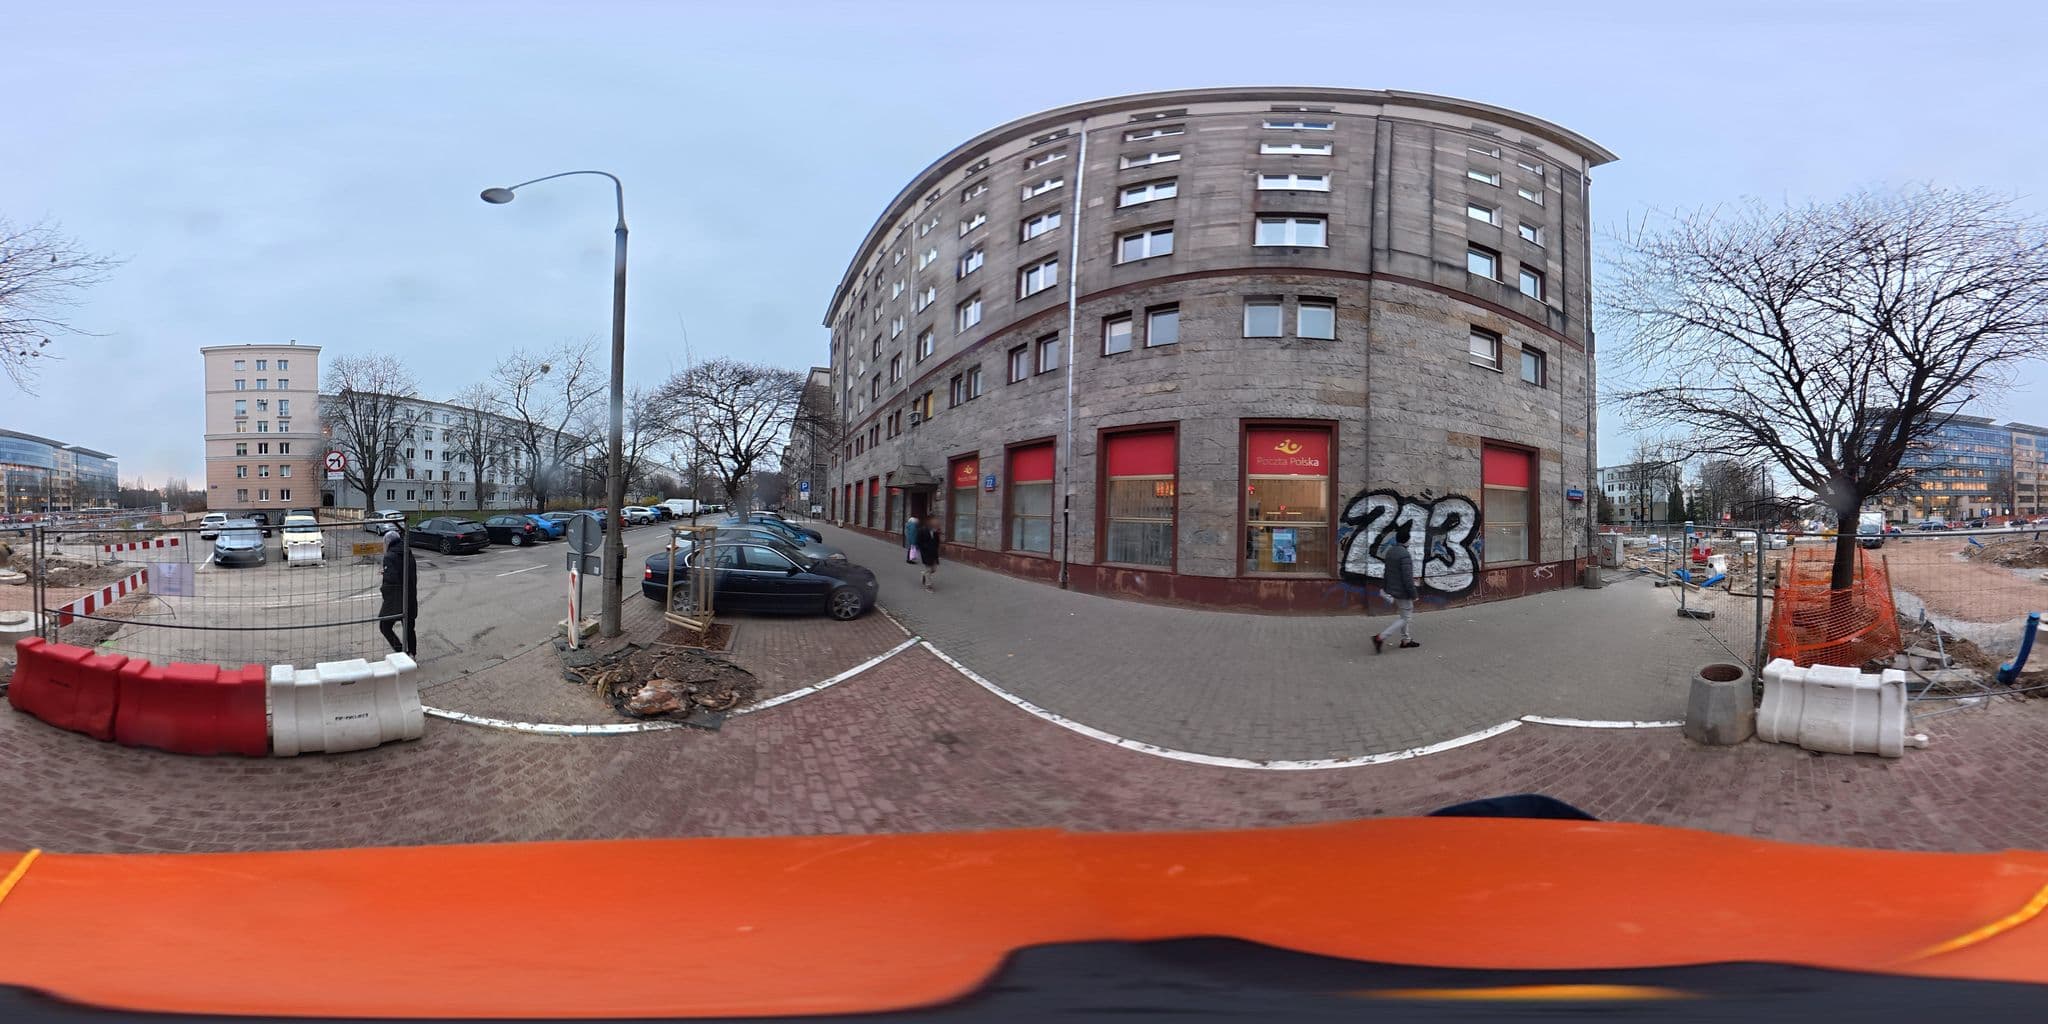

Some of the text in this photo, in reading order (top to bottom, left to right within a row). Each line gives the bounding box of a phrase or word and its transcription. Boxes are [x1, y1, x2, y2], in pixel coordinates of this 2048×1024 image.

[1256, 457, 1320, 467] Poczta Polska
[1340, 488, 1481, 596] 213
